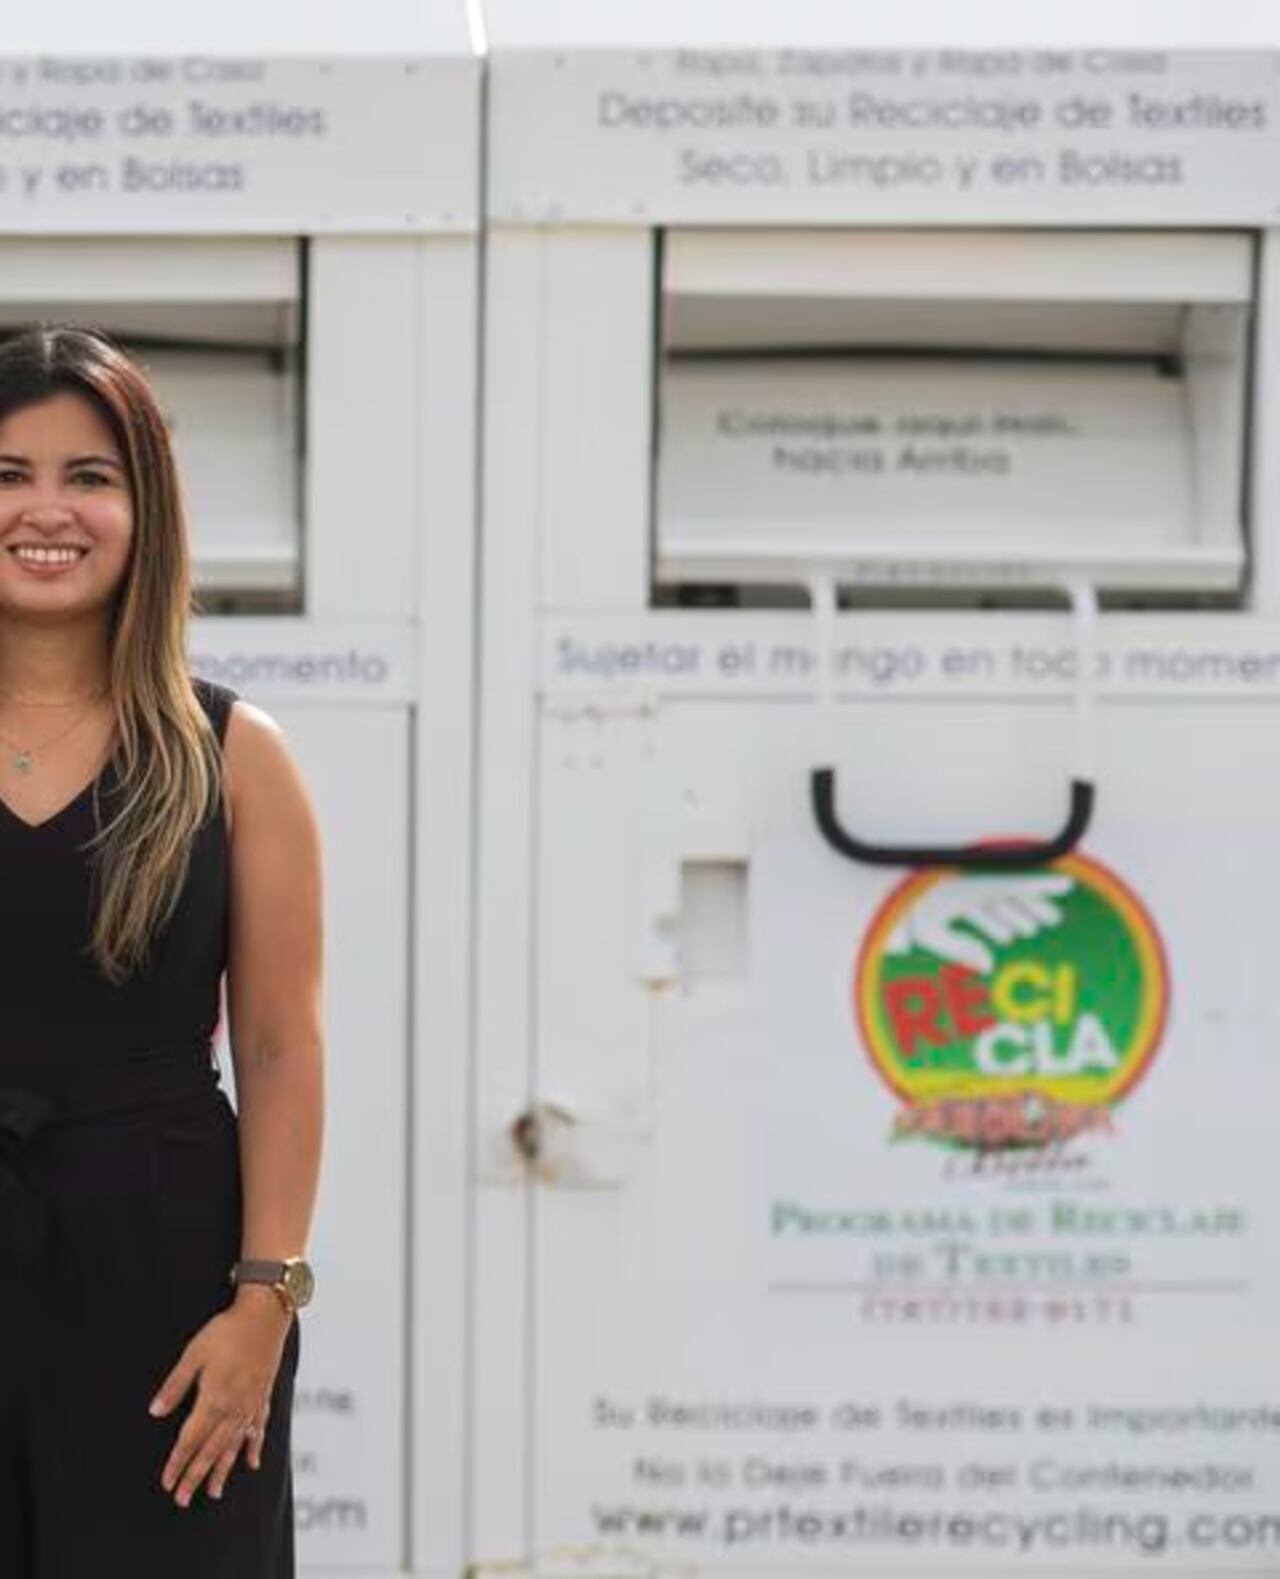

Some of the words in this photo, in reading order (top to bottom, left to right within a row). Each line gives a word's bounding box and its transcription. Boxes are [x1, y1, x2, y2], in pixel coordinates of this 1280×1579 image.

[131, 58, 173, 83] de
[1035, 51, 1073, 75] de
[123, 105, 175, 136] de
[189, 105, 327, 136] Textiles
[597, 92, 778, 131] Deposite
[792, 102, 836, 128] su
[851, 92, 1040, 131] Reciclaje
[1055, 95, 1111, 128] de
[1126, 93, 1265, 128] Textiles
[19, 166, 41, 197] y
[55, 164, 107, 192] en
[122, 158, 244, 192] Bolsas
[808, 149, 942, 188] Limpio
[957, 159, 975, 188] y
[991, 157, 1045, 184] en
[1058, 150, 1184, 185] Bolsas
[558, 637, 698, 680] Sujetar
[719, 640, 756, 676] el
[939, 647, 994, 678] en
[594, 1401, 634, 1430] Su
[647, 1401, 816, 1434] Reciclaje
[831, 1403, 880, 1430] de
[897, 1401, 1020, 1430] Textiles
[1037, 1406, 1072, 1430] es
[636, 1460, 684, 1488] No
[698, 1460, 728, 1488] lo
[744, 1460, 825, 1492] Deje
[841, 1460, 945, 1488] Fuera
[957, 1460, 1013, 1488] del
